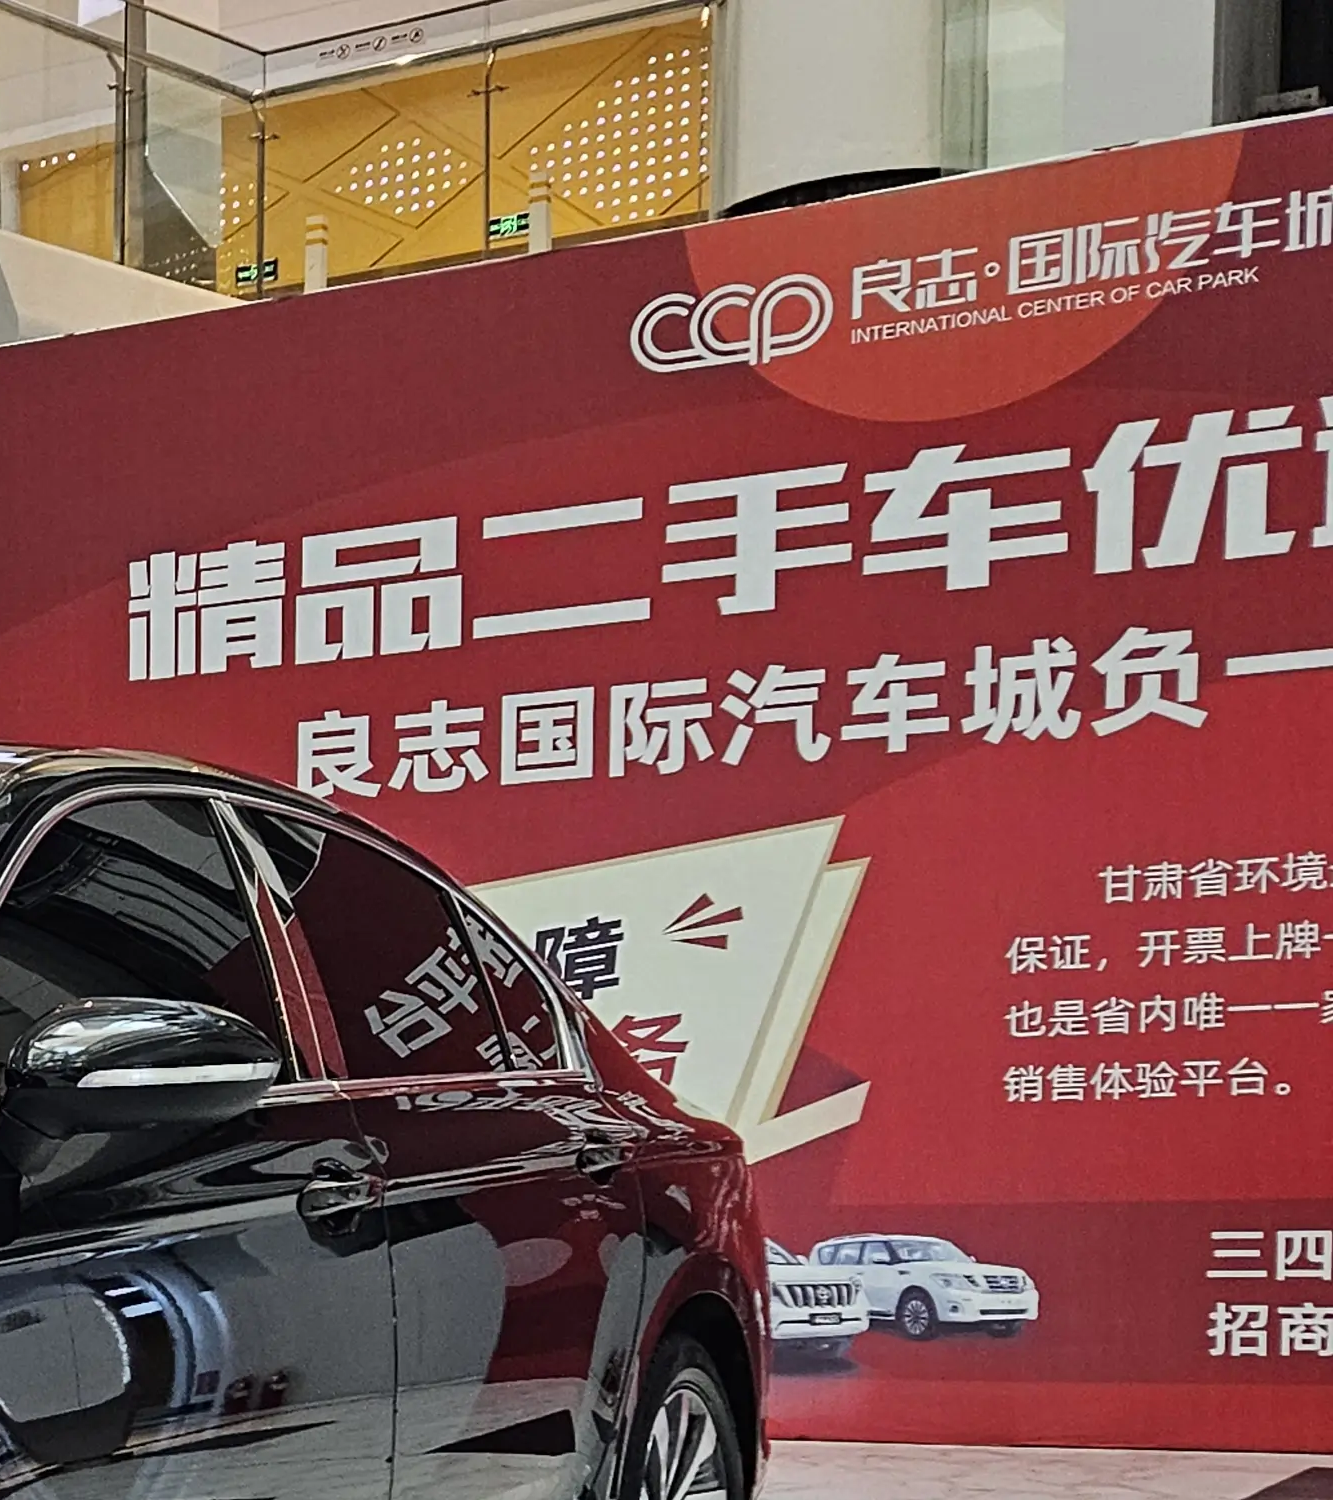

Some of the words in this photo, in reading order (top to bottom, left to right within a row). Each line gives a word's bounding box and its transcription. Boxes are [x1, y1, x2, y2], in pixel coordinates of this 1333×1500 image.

[850, 305, 1012, 345] INTERNATIONAL
[1017, 288, 1104, 319] CENTER
[1109, 283, 1141, 304] OF
[1145, 274, 1193, 299] CAR
[1197, 266, 1260, 291] PARK
[129, 397, 1333, 681] 精品二手车优
[1098, 850, 1333, 904] 甘肃省环境
[1004, 919, 1333, 975] 保证，开票上牌
[1002, 1057, 1294, 1103] 销售体验平台。
[1206, 1229, 1333, 1281] 三四
[1206, 1302, 1333, 1357] 招商
